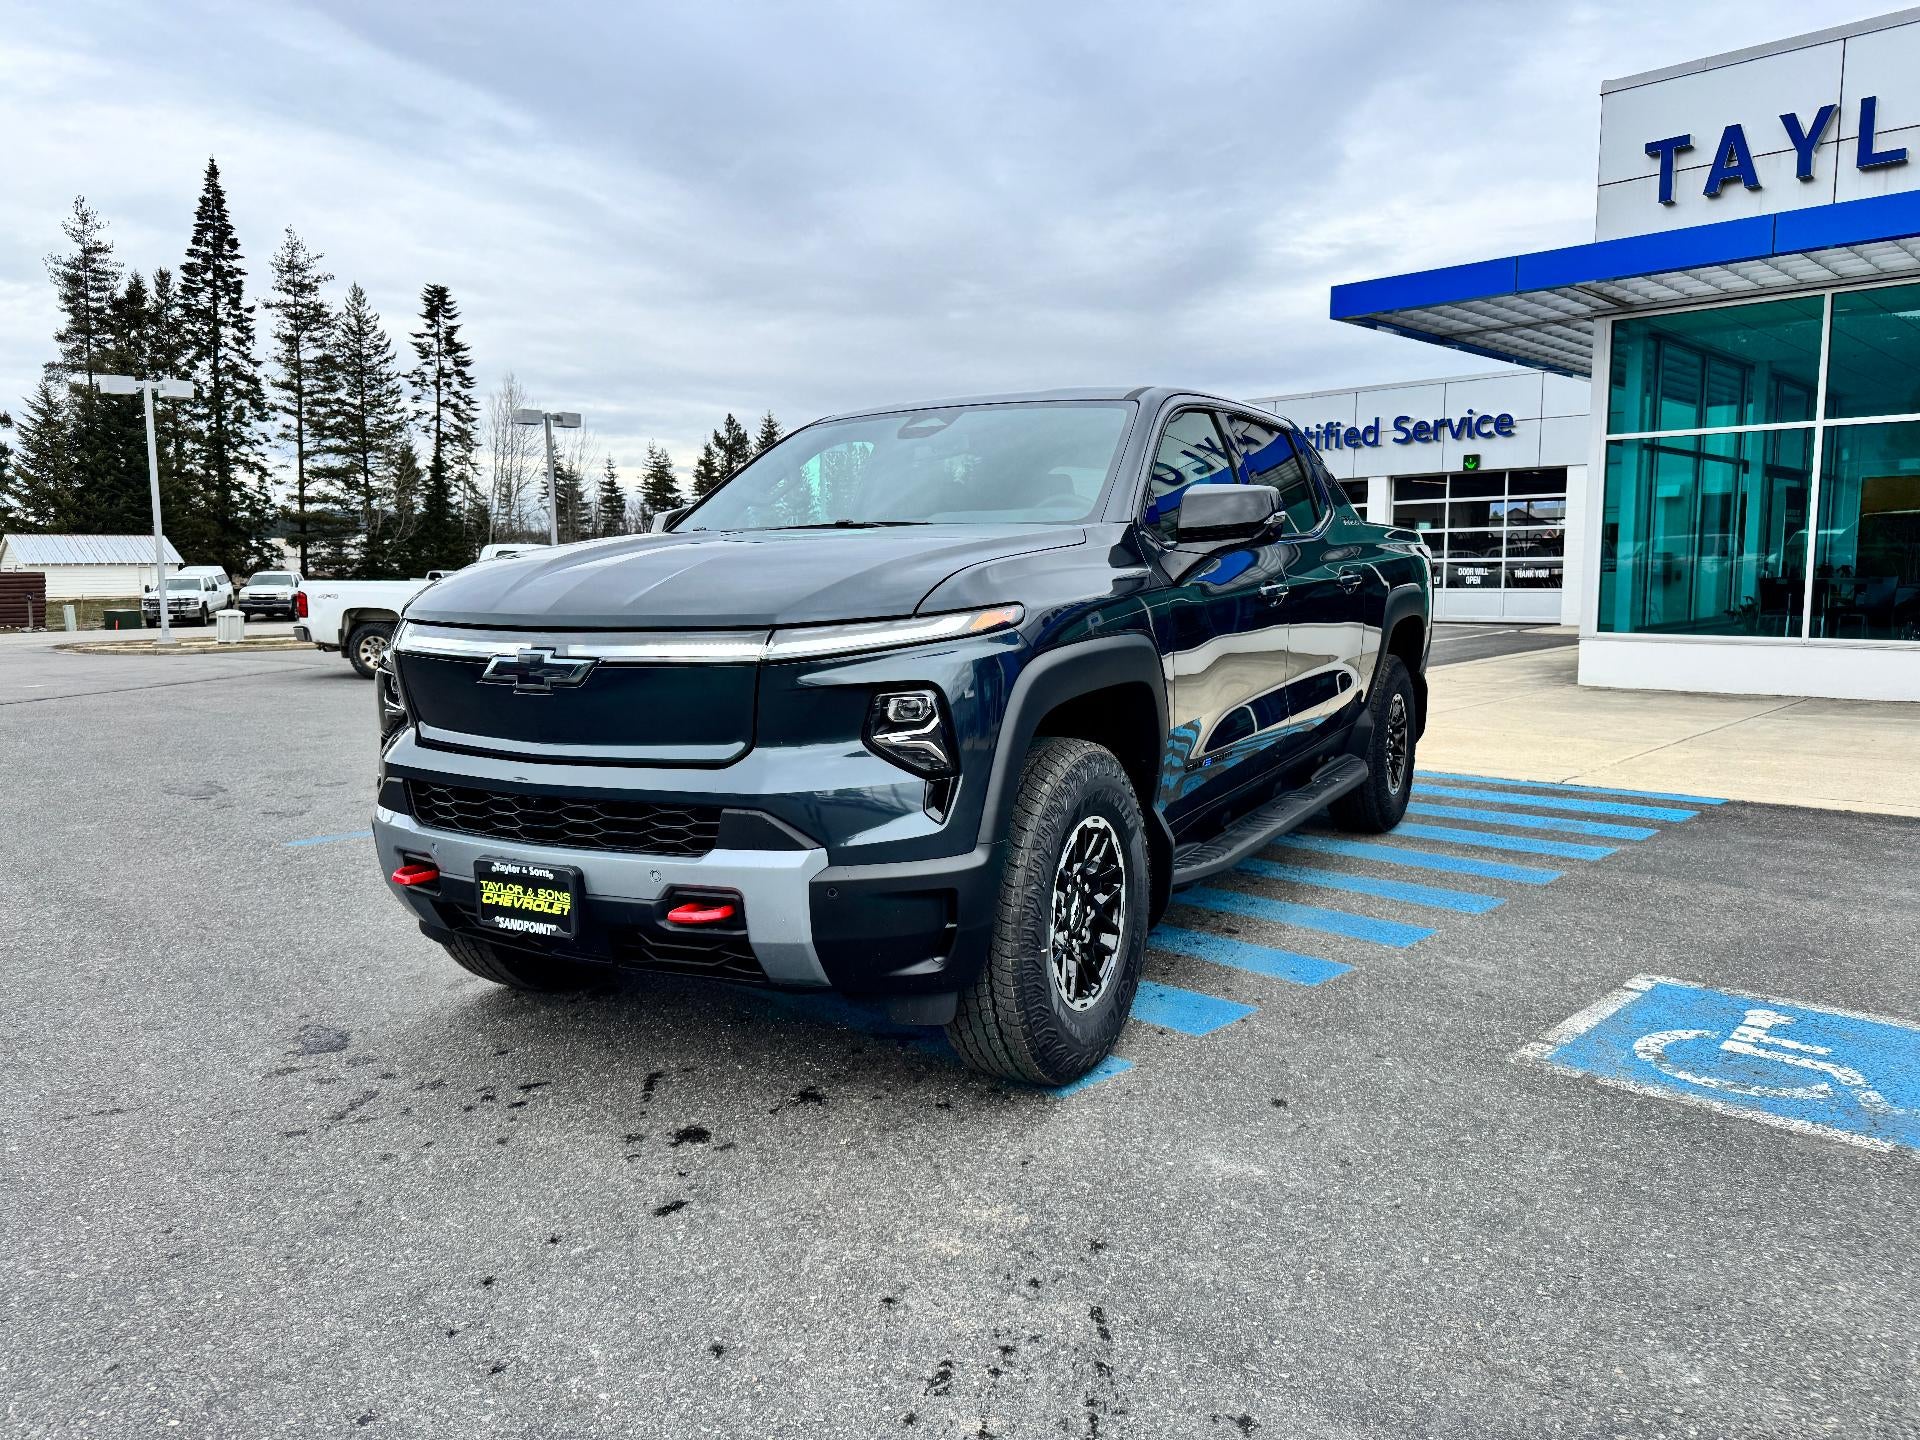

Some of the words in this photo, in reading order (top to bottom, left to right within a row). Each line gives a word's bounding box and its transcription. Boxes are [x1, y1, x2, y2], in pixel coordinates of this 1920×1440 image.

[1645, 95, 1909, 205] TAYL
[1392, 409, 1515, 445] Service
[1465, 576, 1480, 584] OPEN
[1475, 567, 1488, 575] WILL
[1514, 569, 1534, 578] THANK
[493, 862, 520, 875] Taylor
[521, 866, 528, 874] &
[529, 866, 550, 878] Sons
[480, 880, 523, 896] TAYLOR
[526, 887, 534, 898] &
[537, 888, 571, 903] SONS
[481, 892, 571, 916] CHEVROLET
